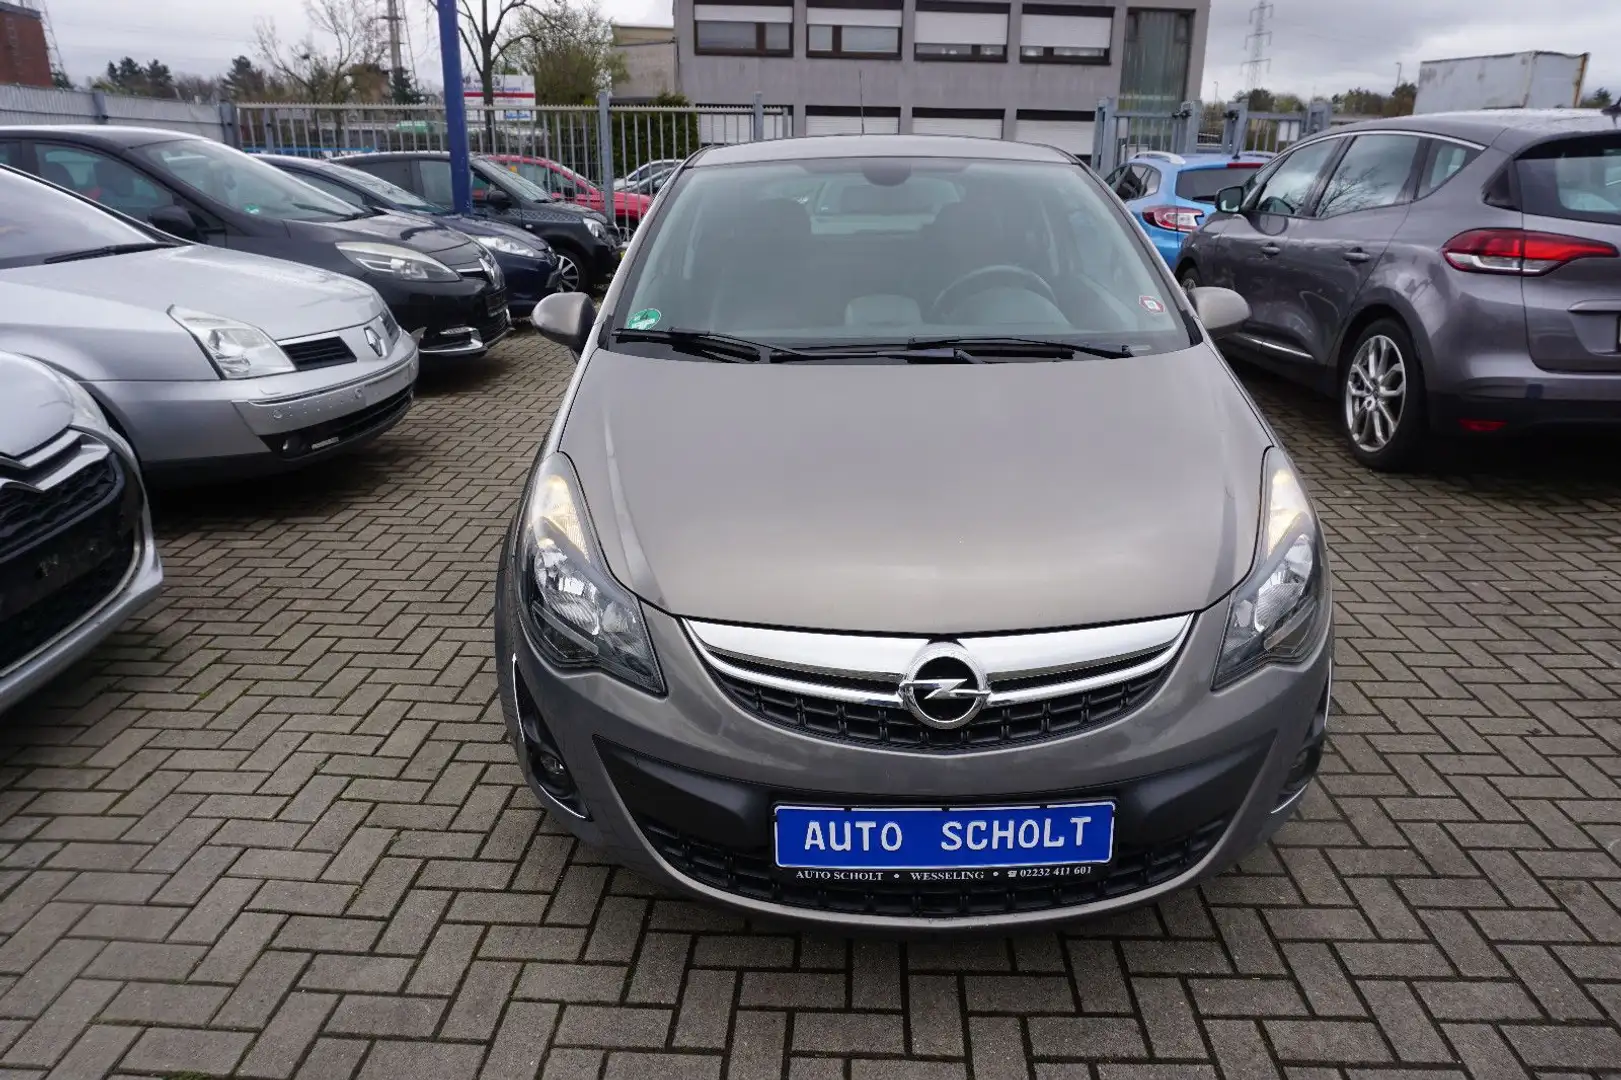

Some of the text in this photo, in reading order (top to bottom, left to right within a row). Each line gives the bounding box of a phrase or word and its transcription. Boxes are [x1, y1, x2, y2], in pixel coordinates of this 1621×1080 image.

[804, 816, 1092, 851] AUTO SCHOLT
[796, 866, 1092, 881] AUTO SCHOLT WESSELING 02232 411 601
